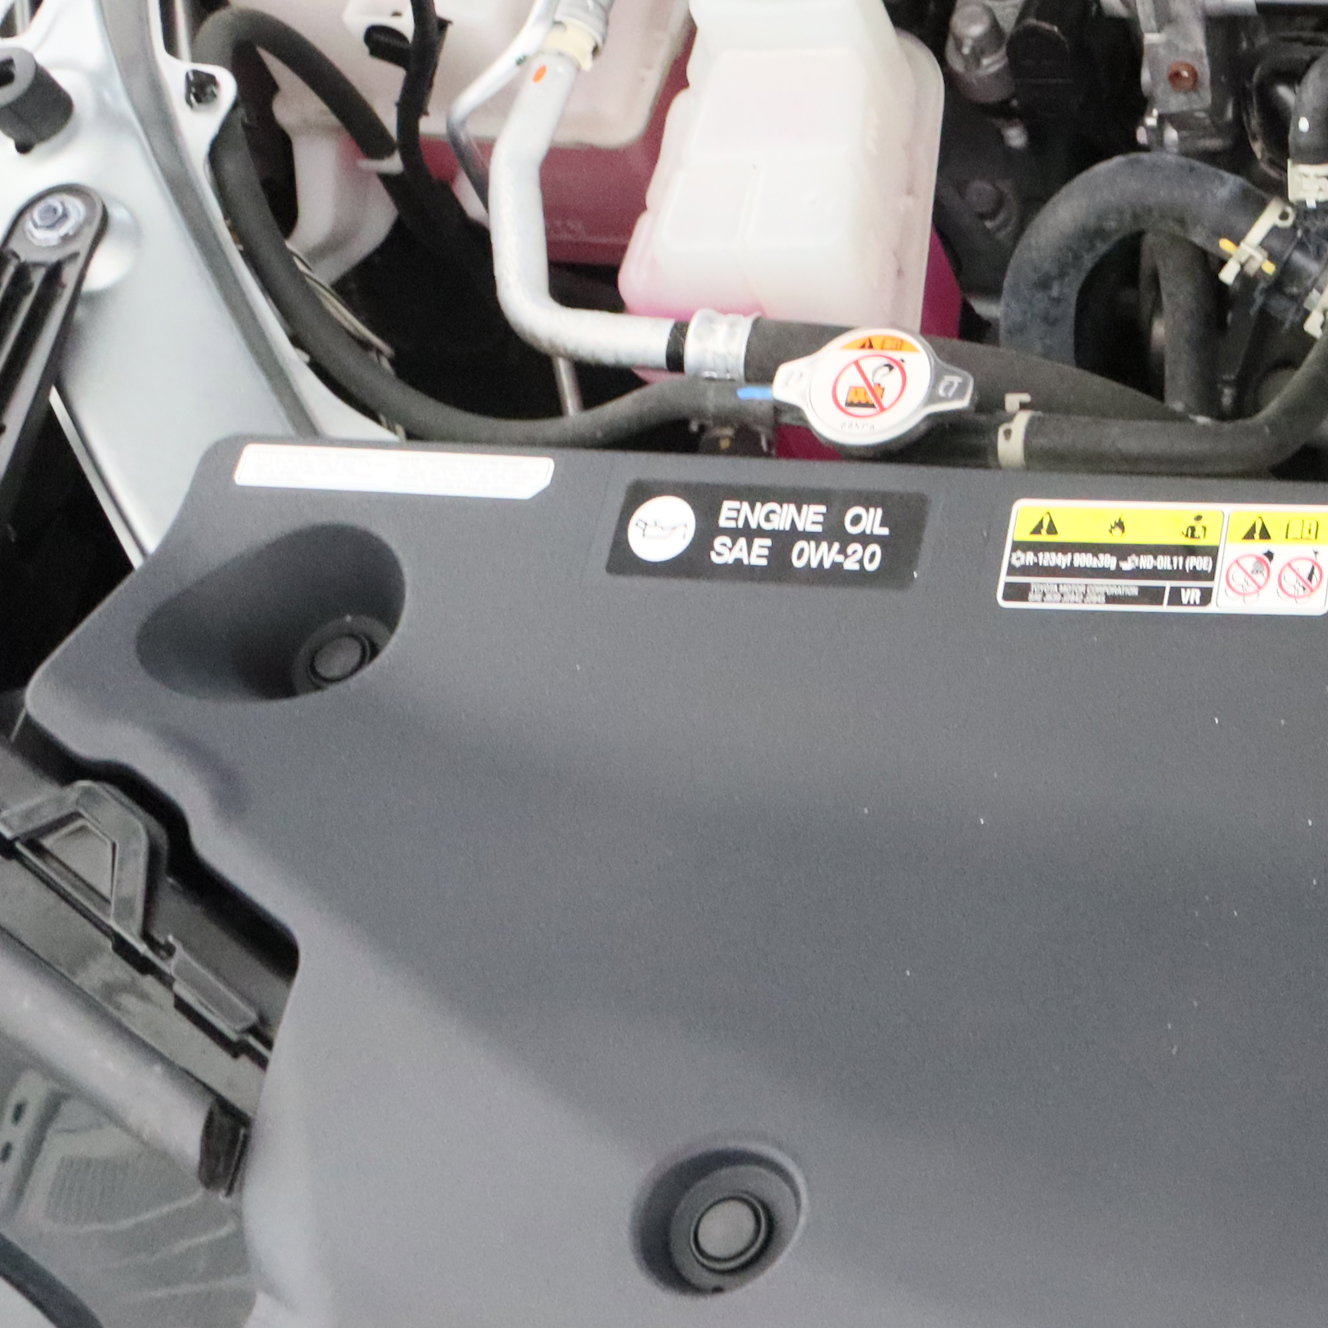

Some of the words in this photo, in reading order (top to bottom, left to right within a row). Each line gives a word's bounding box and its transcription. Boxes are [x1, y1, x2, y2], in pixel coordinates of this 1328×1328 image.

[717, 499, 828, 533] ENGINE
[843, 505, 890, 536] OIL
[709, 535, 773, 566] SAE
[790, 539, 882, 572] 0W-20
[1180, 587, 1202, 605] VR
